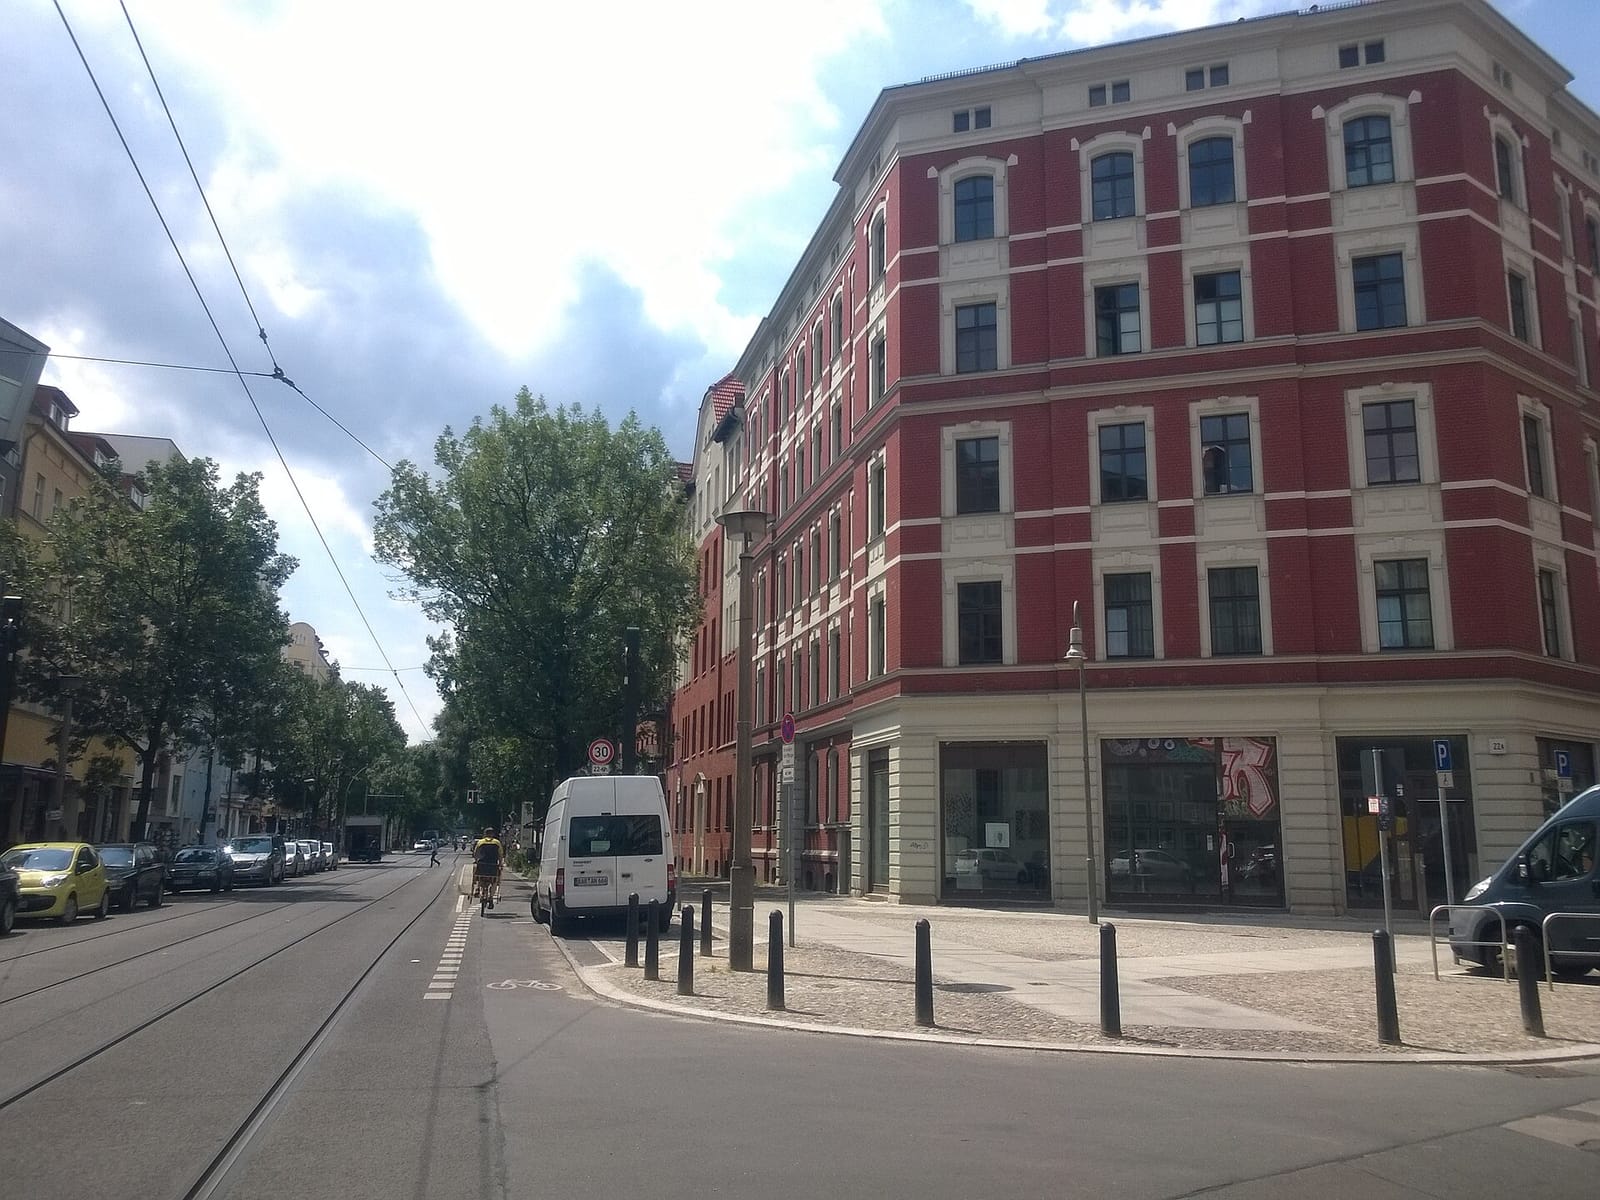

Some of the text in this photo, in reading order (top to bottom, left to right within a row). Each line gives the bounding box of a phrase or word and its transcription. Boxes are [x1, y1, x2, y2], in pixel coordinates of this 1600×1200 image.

[594, 746, 608, 758] 30
[1438, 744, 1447, 767] P
[1559, 754, 1567, 774] P
